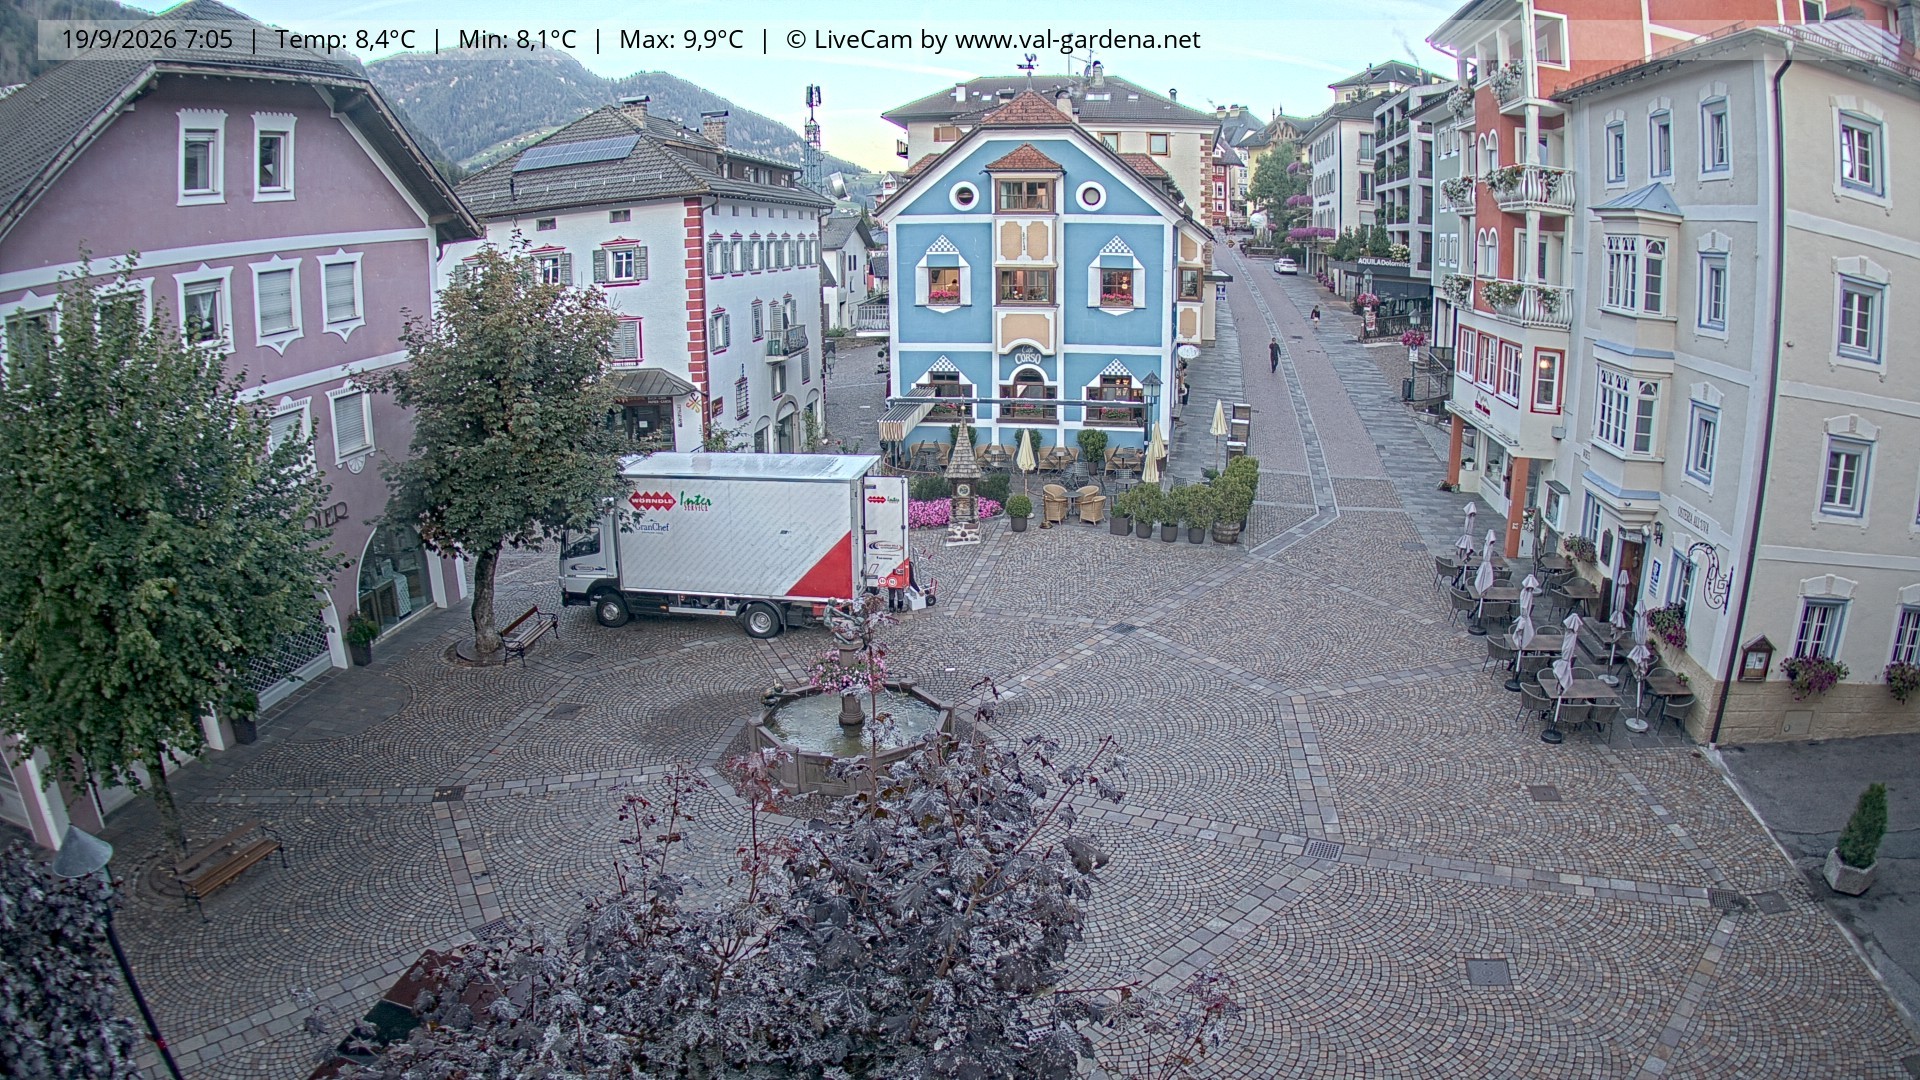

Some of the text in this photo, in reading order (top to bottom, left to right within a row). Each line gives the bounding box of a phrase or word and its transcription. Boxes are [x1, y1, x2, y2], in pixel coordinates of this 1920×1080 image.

[1014, 353, 1042, 365] CORSO
[631, 497, 674, 505] WÖRNDLE
[680, 490, 712, 507] Inter
